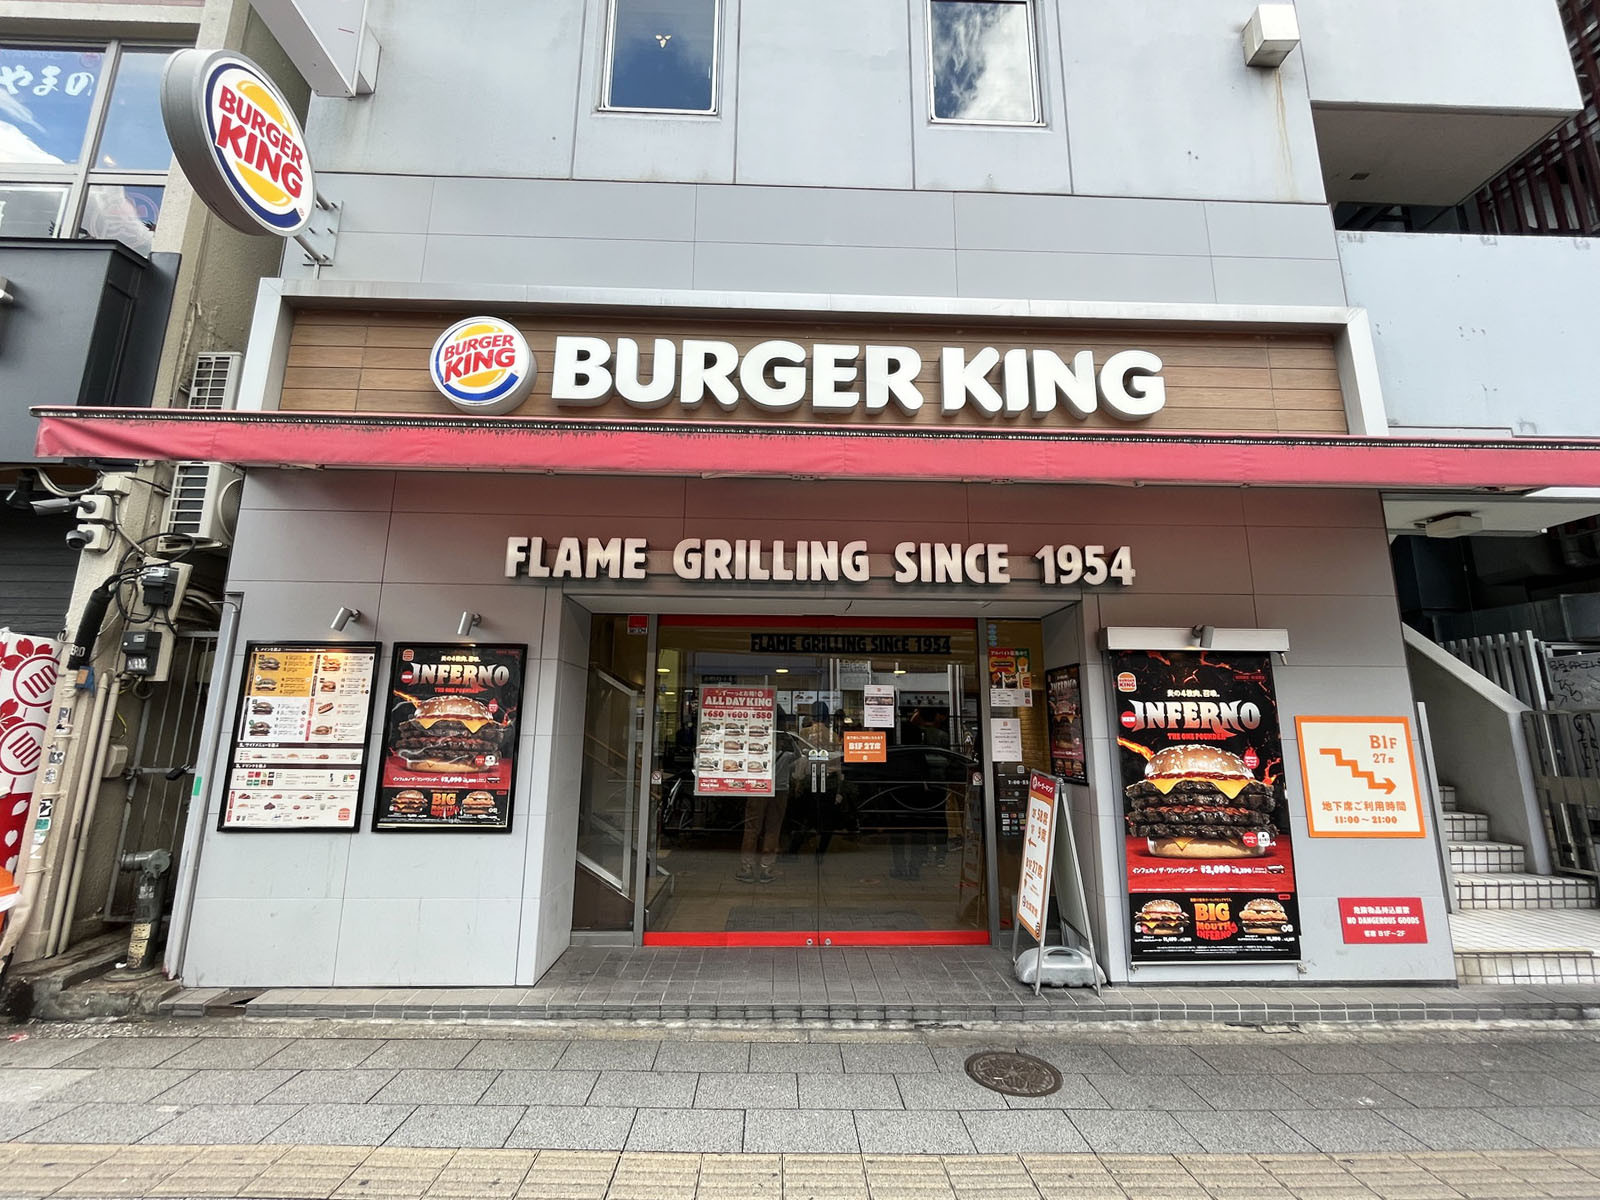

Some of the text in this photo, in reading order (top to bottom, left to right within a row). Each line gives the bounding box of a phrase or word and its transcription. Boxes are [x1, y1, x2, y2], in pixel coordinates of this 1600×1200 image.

[220, 85, 304, 172] BURGER
[215, 120, 304, 201] KING
[443, 334, 515, 363] BURGER
[443, 349, 516, 385] KING
[551, 335, 1167, 424] BURGER KING
[505, 536, 1137, 586] FLAME GRILLING SINCE 1954
[411, 662, 509, 690] INFERNO
[705, 696, 773, 707] ALL DAY KING
[1128, 699, 1261, 734] INFERNO
[1369, 735, 1397, 749] B1F
[431, 793, 457, 806] BIG
[1322, 801, 1407, 812] 地下席ご利用時間
[1334, 815, 1359, 825] 11:00
[1372, 815, 1398, 825] 21:00
[1193, 902, 1230, 921] BIG
[1346, 917, 1420, 925] NO DANGEROUS GOODS
[1196, 921, 1232, 931] MOUTH
[1196, 930, 1232, 941] INFERNO
